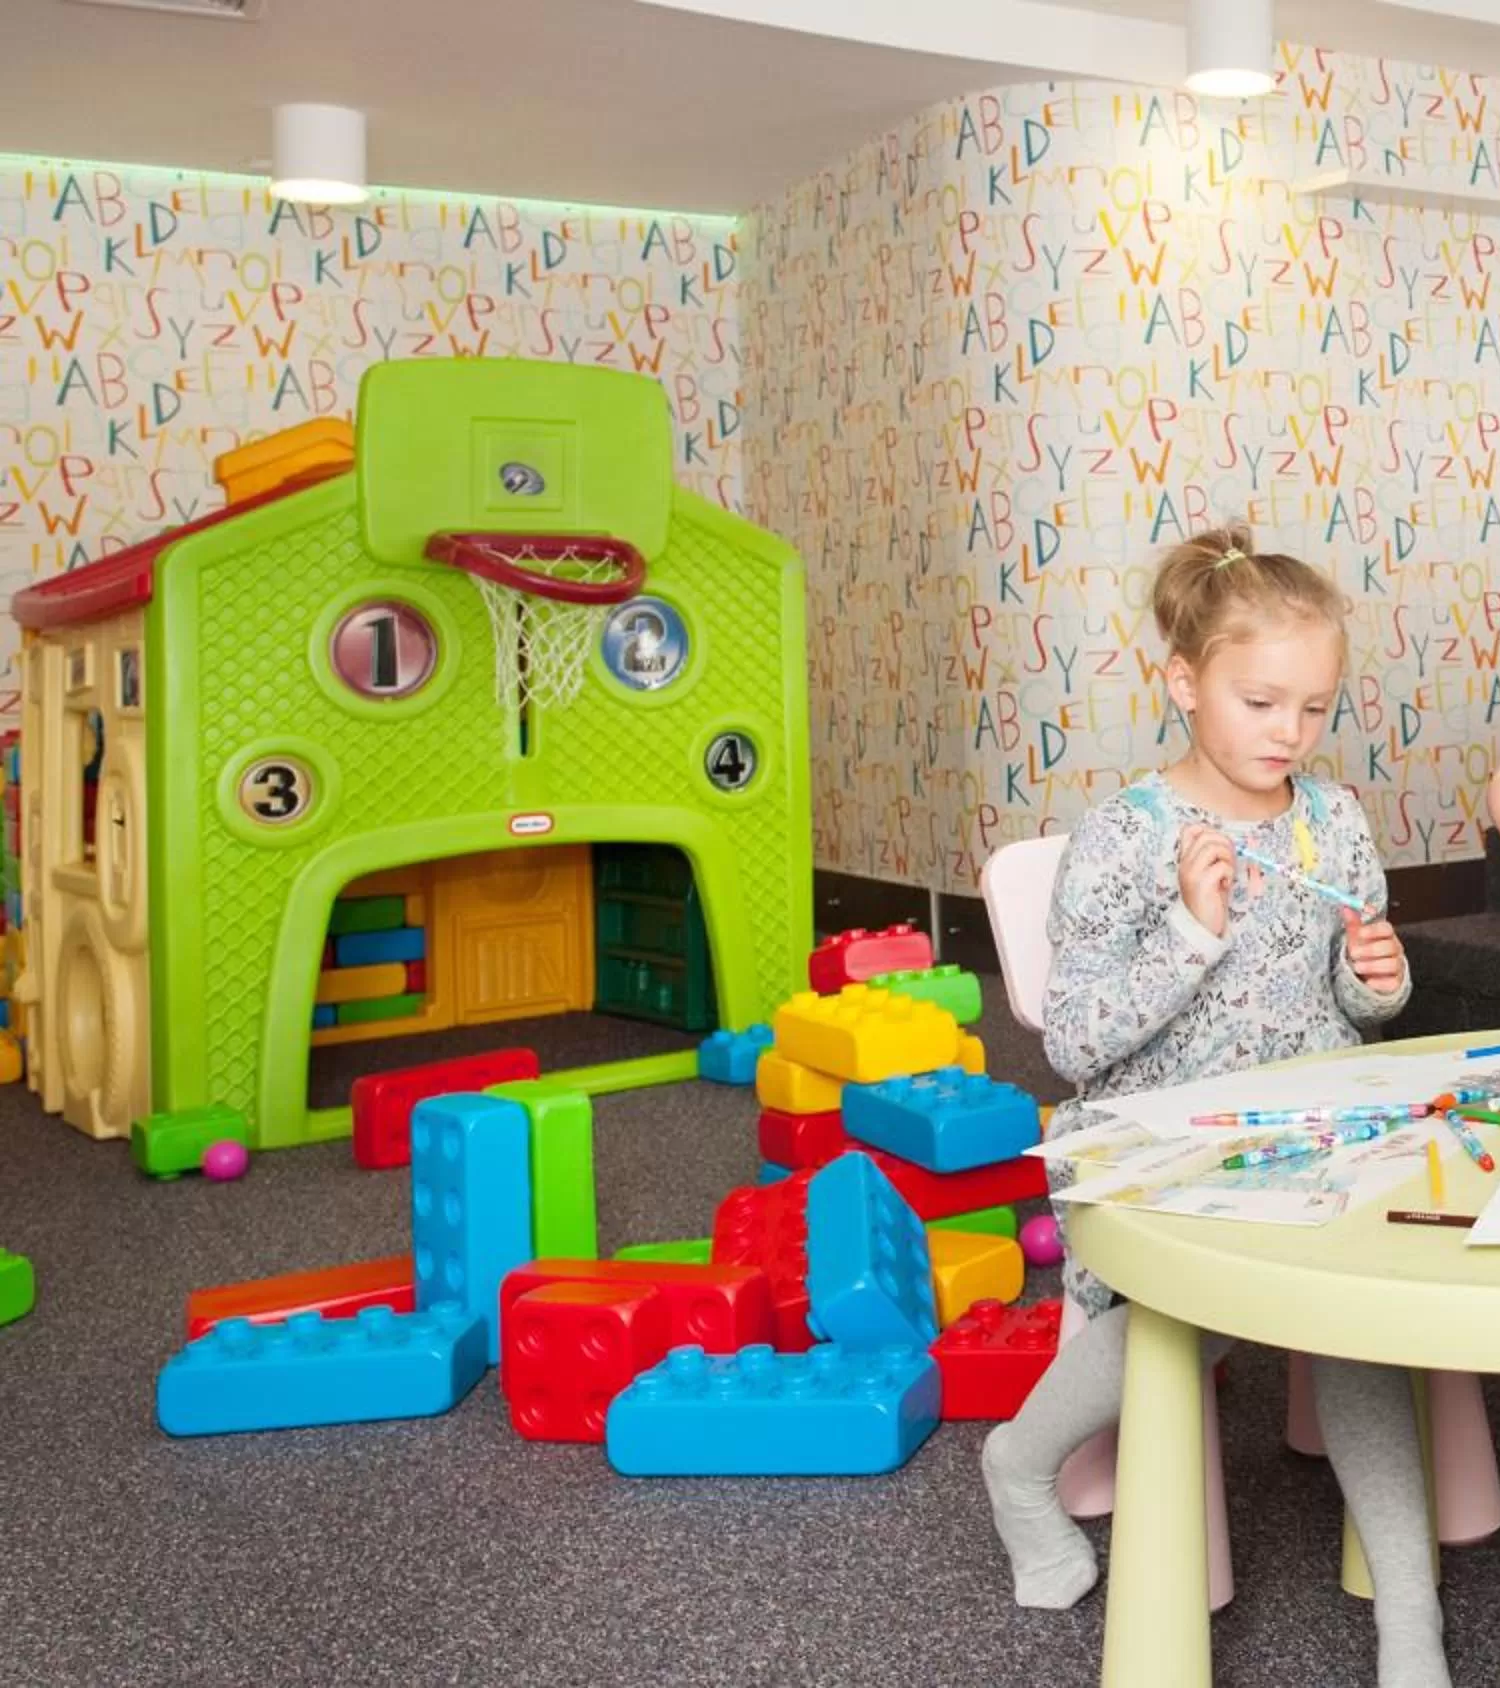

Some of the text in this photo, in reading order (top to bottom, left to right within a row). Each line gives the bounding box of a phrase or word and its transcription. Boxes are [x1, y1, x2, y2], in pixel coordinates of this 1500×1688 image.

[367, 616, 398, 688] 1
[624, 611, 666, 673] 2
[712, 738, 746, 783] 4
[254, 766, 298, 817] 3
